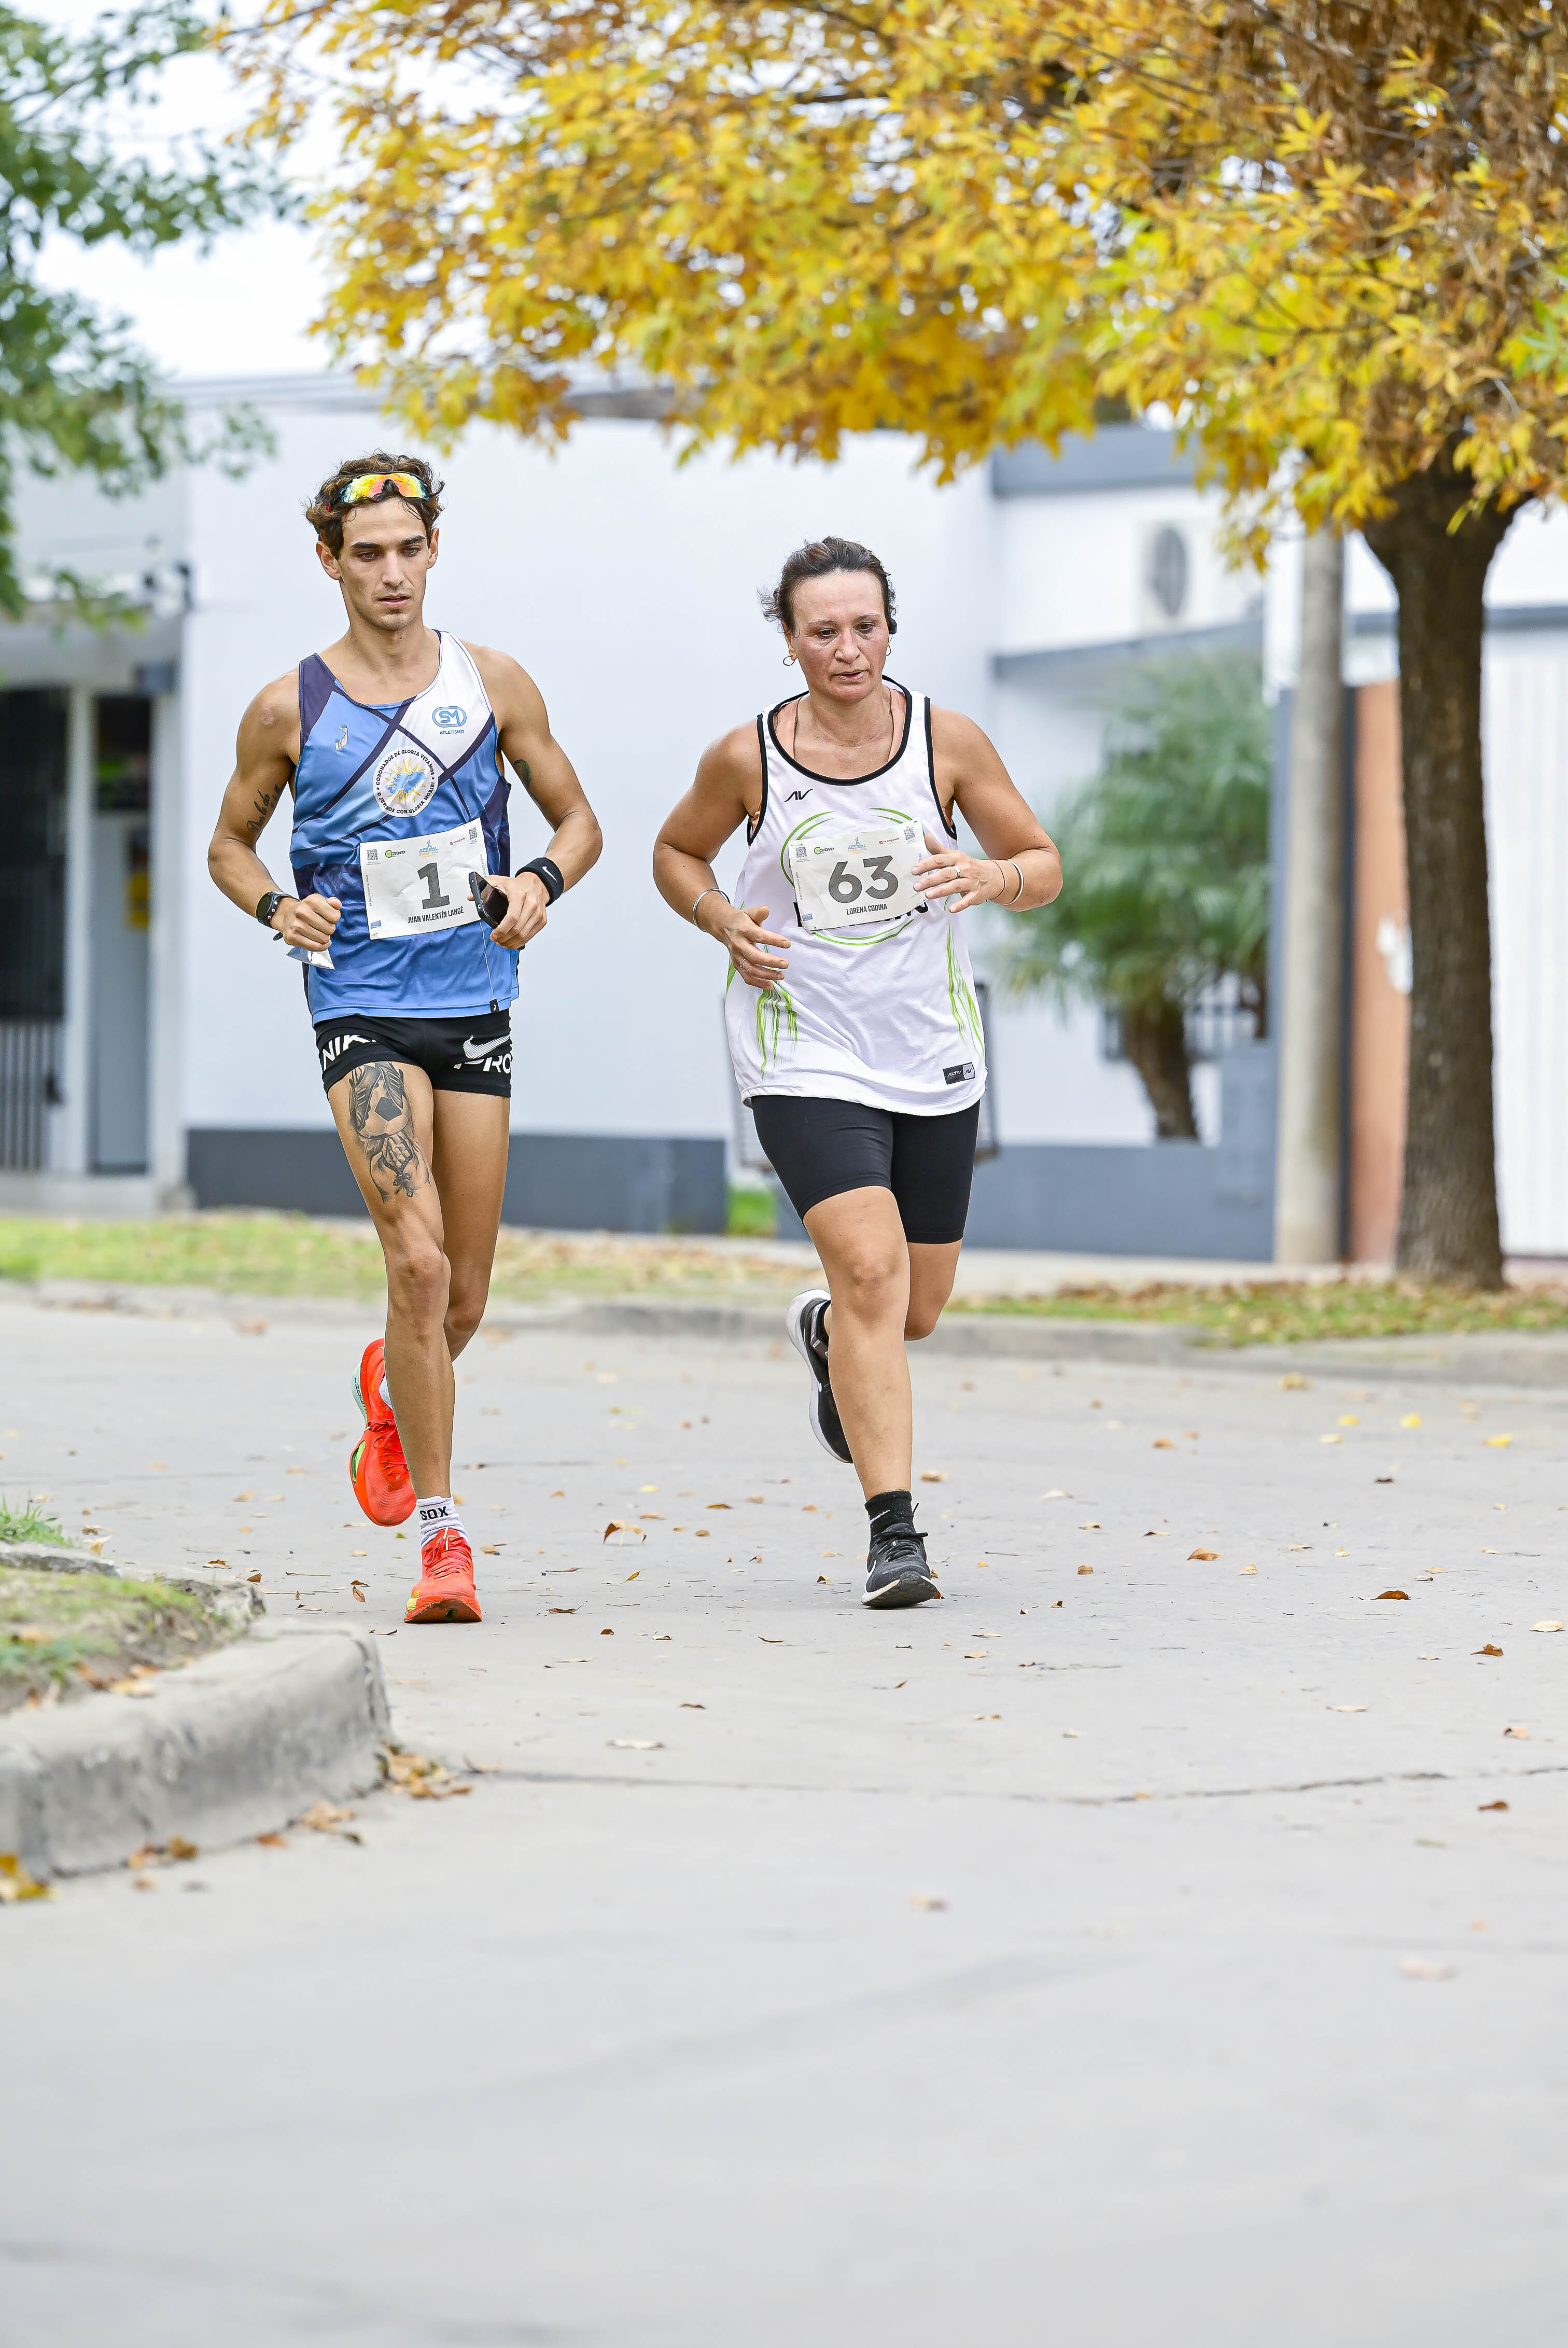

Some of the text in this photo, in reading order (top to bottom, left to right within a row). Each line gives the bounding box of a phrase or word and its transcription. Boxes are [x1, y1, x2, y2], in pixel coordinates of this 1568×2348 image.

[376, 755, 394, 786] CORONADOS
[421, 754, 435, 775] VIVAMOS
[409, 801, 425, 814] GLORIA
[417, 862, 450, 910] 1
[829, 855, 899, 903] 63
[408, 905, 464, 923] JUAN VALENTÍN LANGÉ
[846, 903, 888, 915] LORENA CODINA
[323, 1035, 376, 1071] NIK
[947, 1069, 962, 1078] ALTIV
[419, 1506, 449, 1520] SOX
